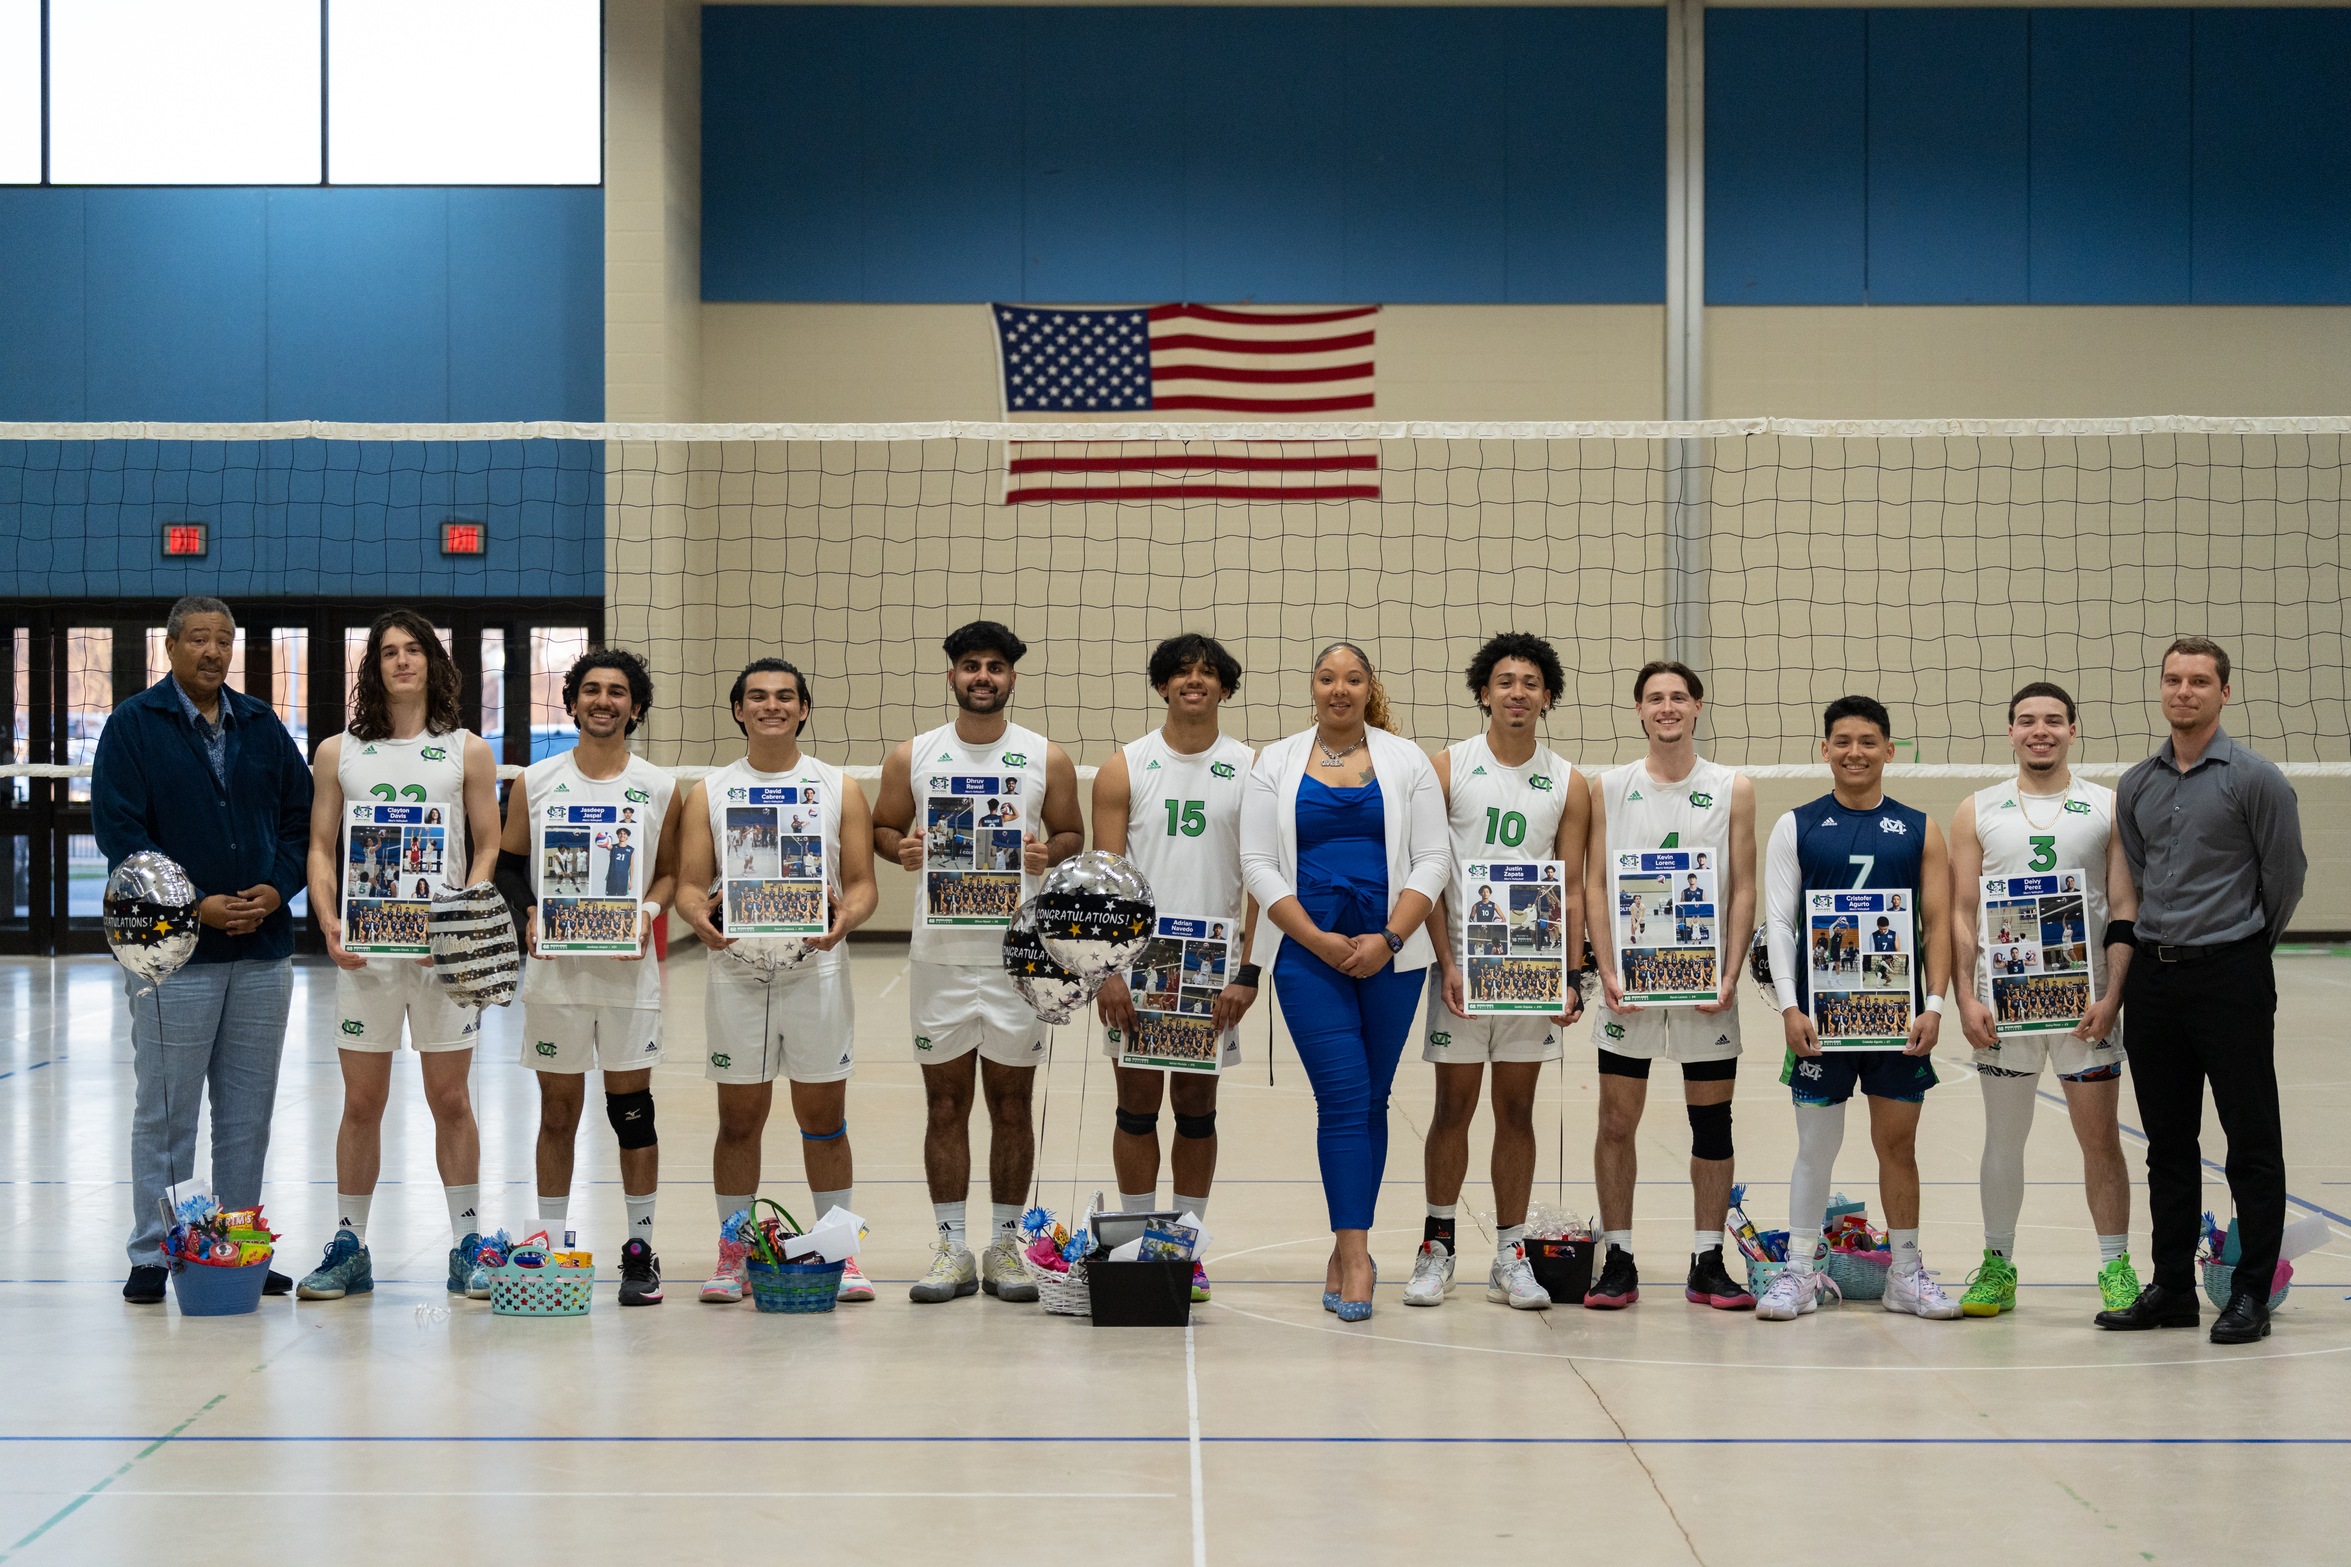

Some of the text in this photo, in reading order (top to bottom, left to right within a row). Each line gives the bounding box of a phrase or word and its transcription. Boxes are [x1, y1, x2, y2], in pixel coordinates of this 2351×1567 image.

[387, 807, 410, 815] Clayton
[1165, 799, 1206, 837] 15
[1486, 807, 1527, 847] 10
[1849, 854, 1874, 889] 7
[2028, 836, 2057, 872] 3
[1036, 908, 1130, 925] CONGRATULATIONS!
